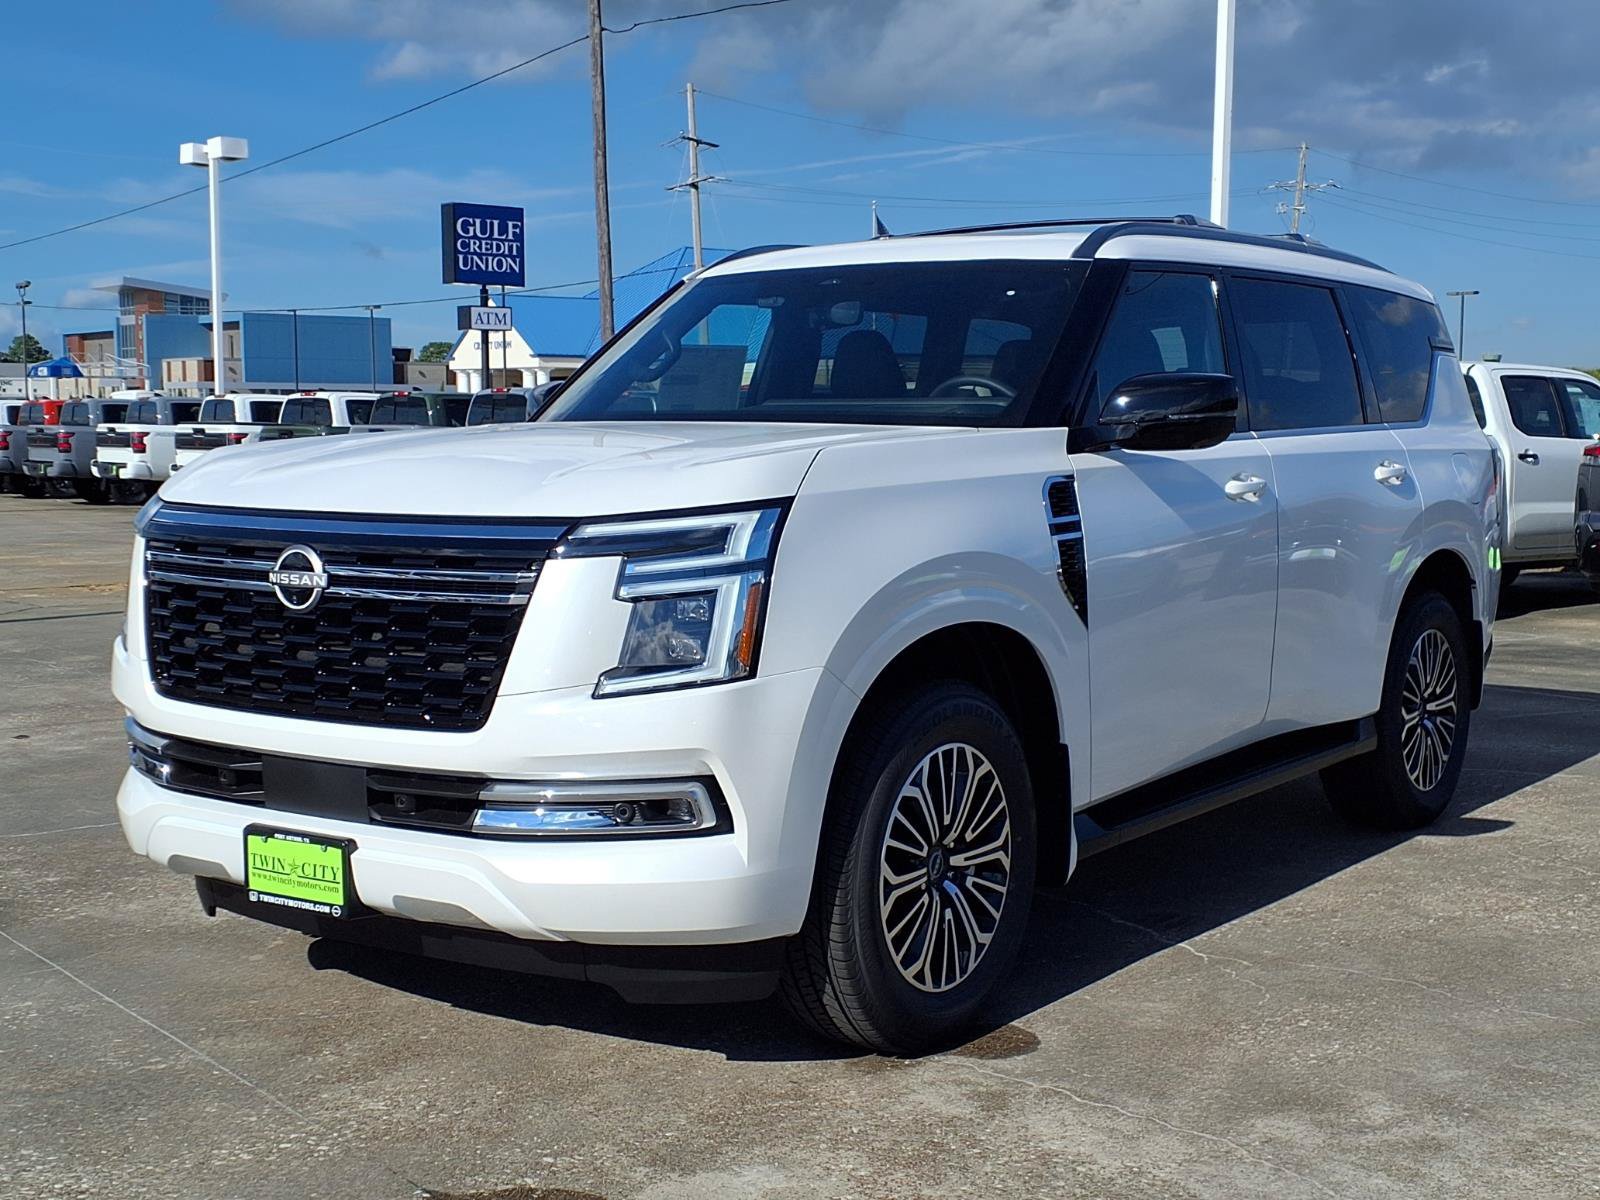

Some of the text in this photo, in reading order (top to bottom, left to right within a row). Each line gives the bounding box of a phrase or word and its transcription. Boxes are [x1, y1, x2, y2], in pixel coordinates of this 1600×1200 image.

[456, 217, 521, 240] GULF
[457, 238, 520, 255] CREDIT
[457, 254, 520, 273] UNION
[474, 312, 507, 326] ATM
[268, 572, 326, 586] NISSAN
[250, 852, 340, 881] TWIN CITY
[251, 872, 339, 893] www.twincitymotors.com
[259, 894, 331, 913] TWINCITYMOTORS.COM
